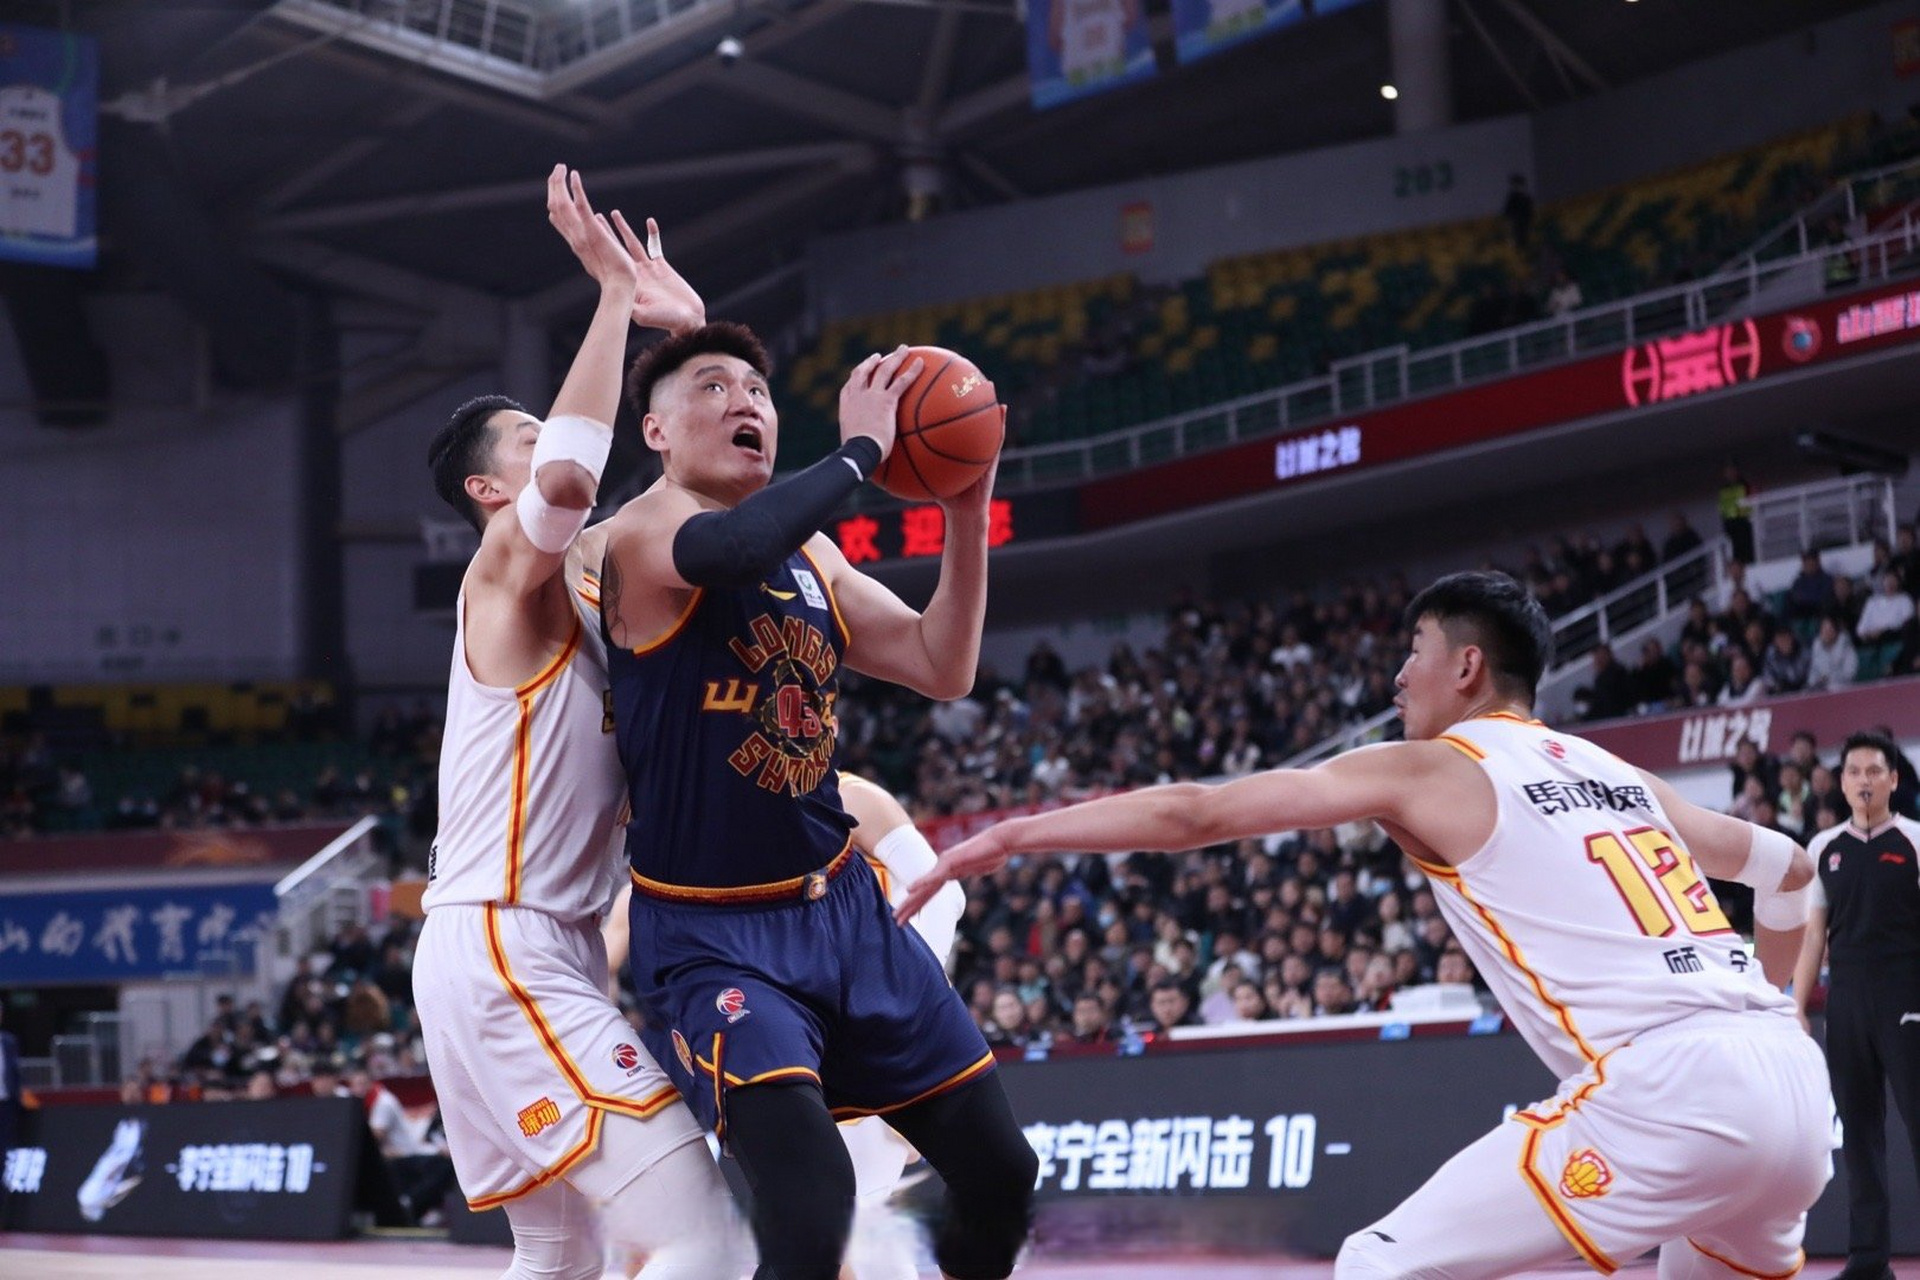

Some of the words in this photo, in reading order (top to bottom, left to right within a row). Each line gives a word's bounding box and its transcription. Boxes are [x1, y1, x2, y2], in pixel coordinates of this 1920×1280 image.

[0, 129, 55, 177] 33
[1584, 826, 1736, 938] 12
[1265, 1114, 1316, 1188] 10
